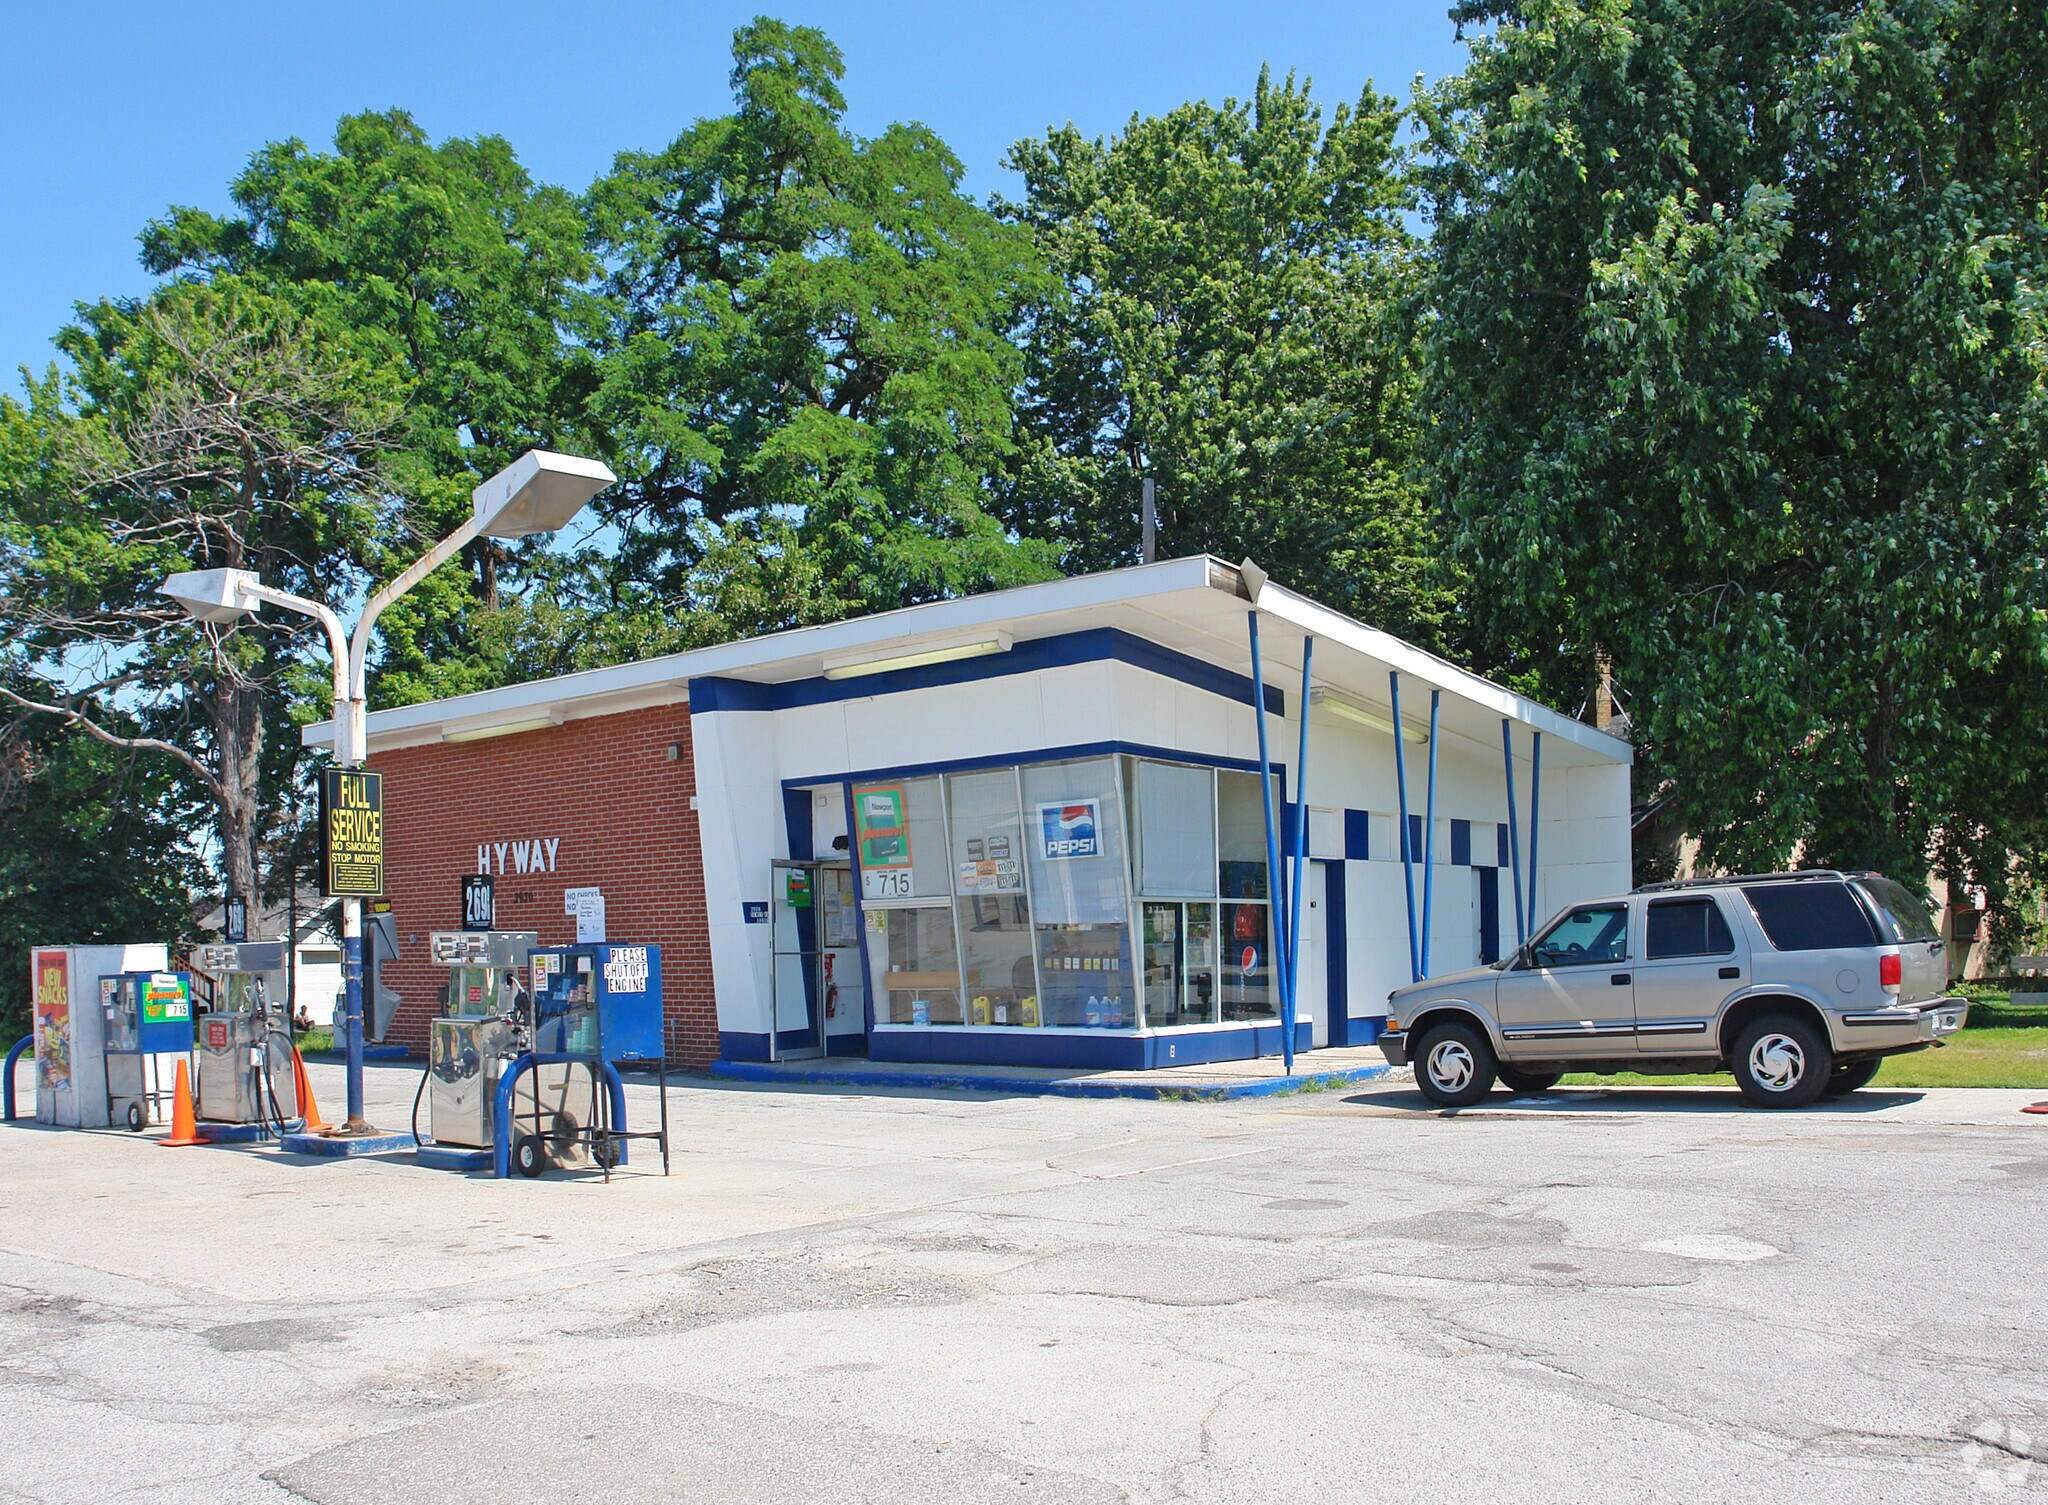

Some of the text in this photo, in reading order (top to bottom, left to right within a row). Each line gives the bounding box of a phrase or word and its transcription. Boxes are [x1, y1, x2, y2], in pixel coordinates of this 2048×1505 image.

[341, 775, 370, 809] FULL
[331, 808, 380, 842] SERVICE
[331, 841, 380, 852] NO SMOKING
[1047, 838, 1095, 855] PEPSI
[331, 853, 381, 864] STOP MOTOR
[478, 838, 560, 875] HYWAY
[611, 948, 646, 962] PLEASE
[43, 968, 61, 988] NEW
[605, 964, 647, 978] SHUTOFF
[609, 978, 644, 992] ENGINE
[38, 985, 67, 1005] SNACKS
